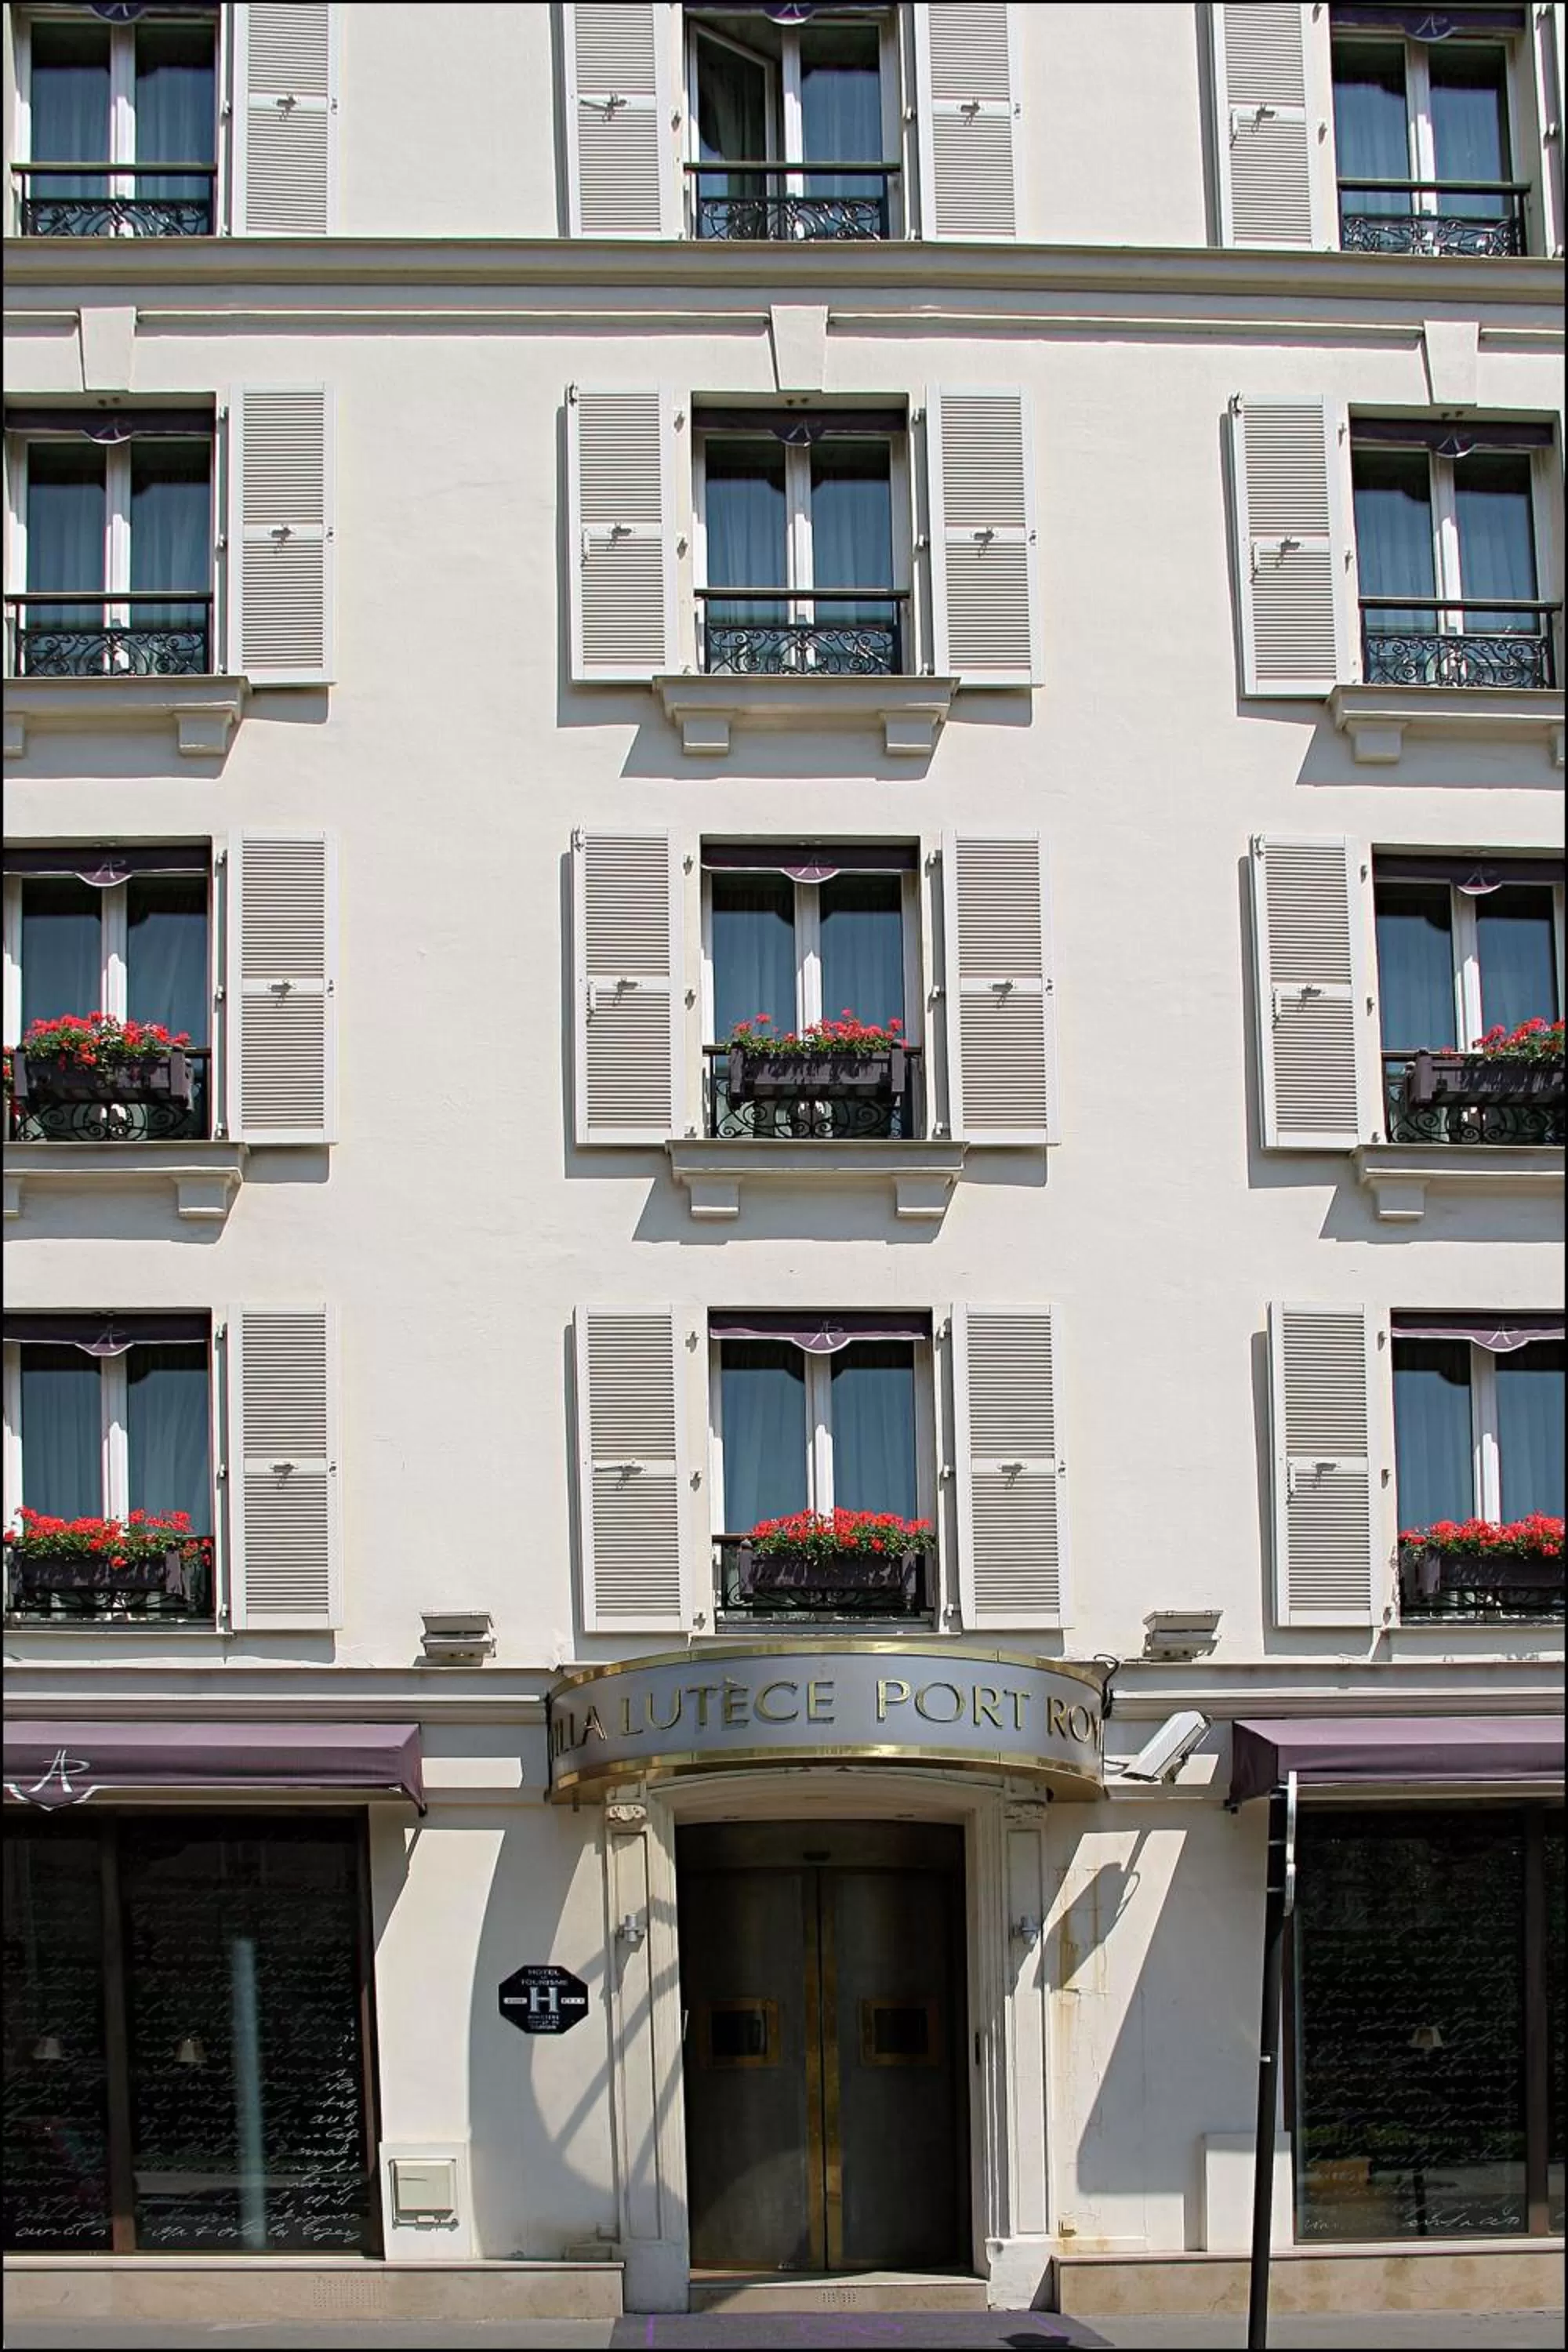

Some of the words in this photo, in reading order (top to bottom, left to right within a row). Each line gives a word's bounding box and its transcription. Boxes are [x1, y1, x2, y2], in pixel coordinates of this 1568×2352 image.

[620, 1676, 835, 1737] LUTÈCE
[876, 1679, 1030, 1730] PORT
[529, 1987, 558, 2013] H
